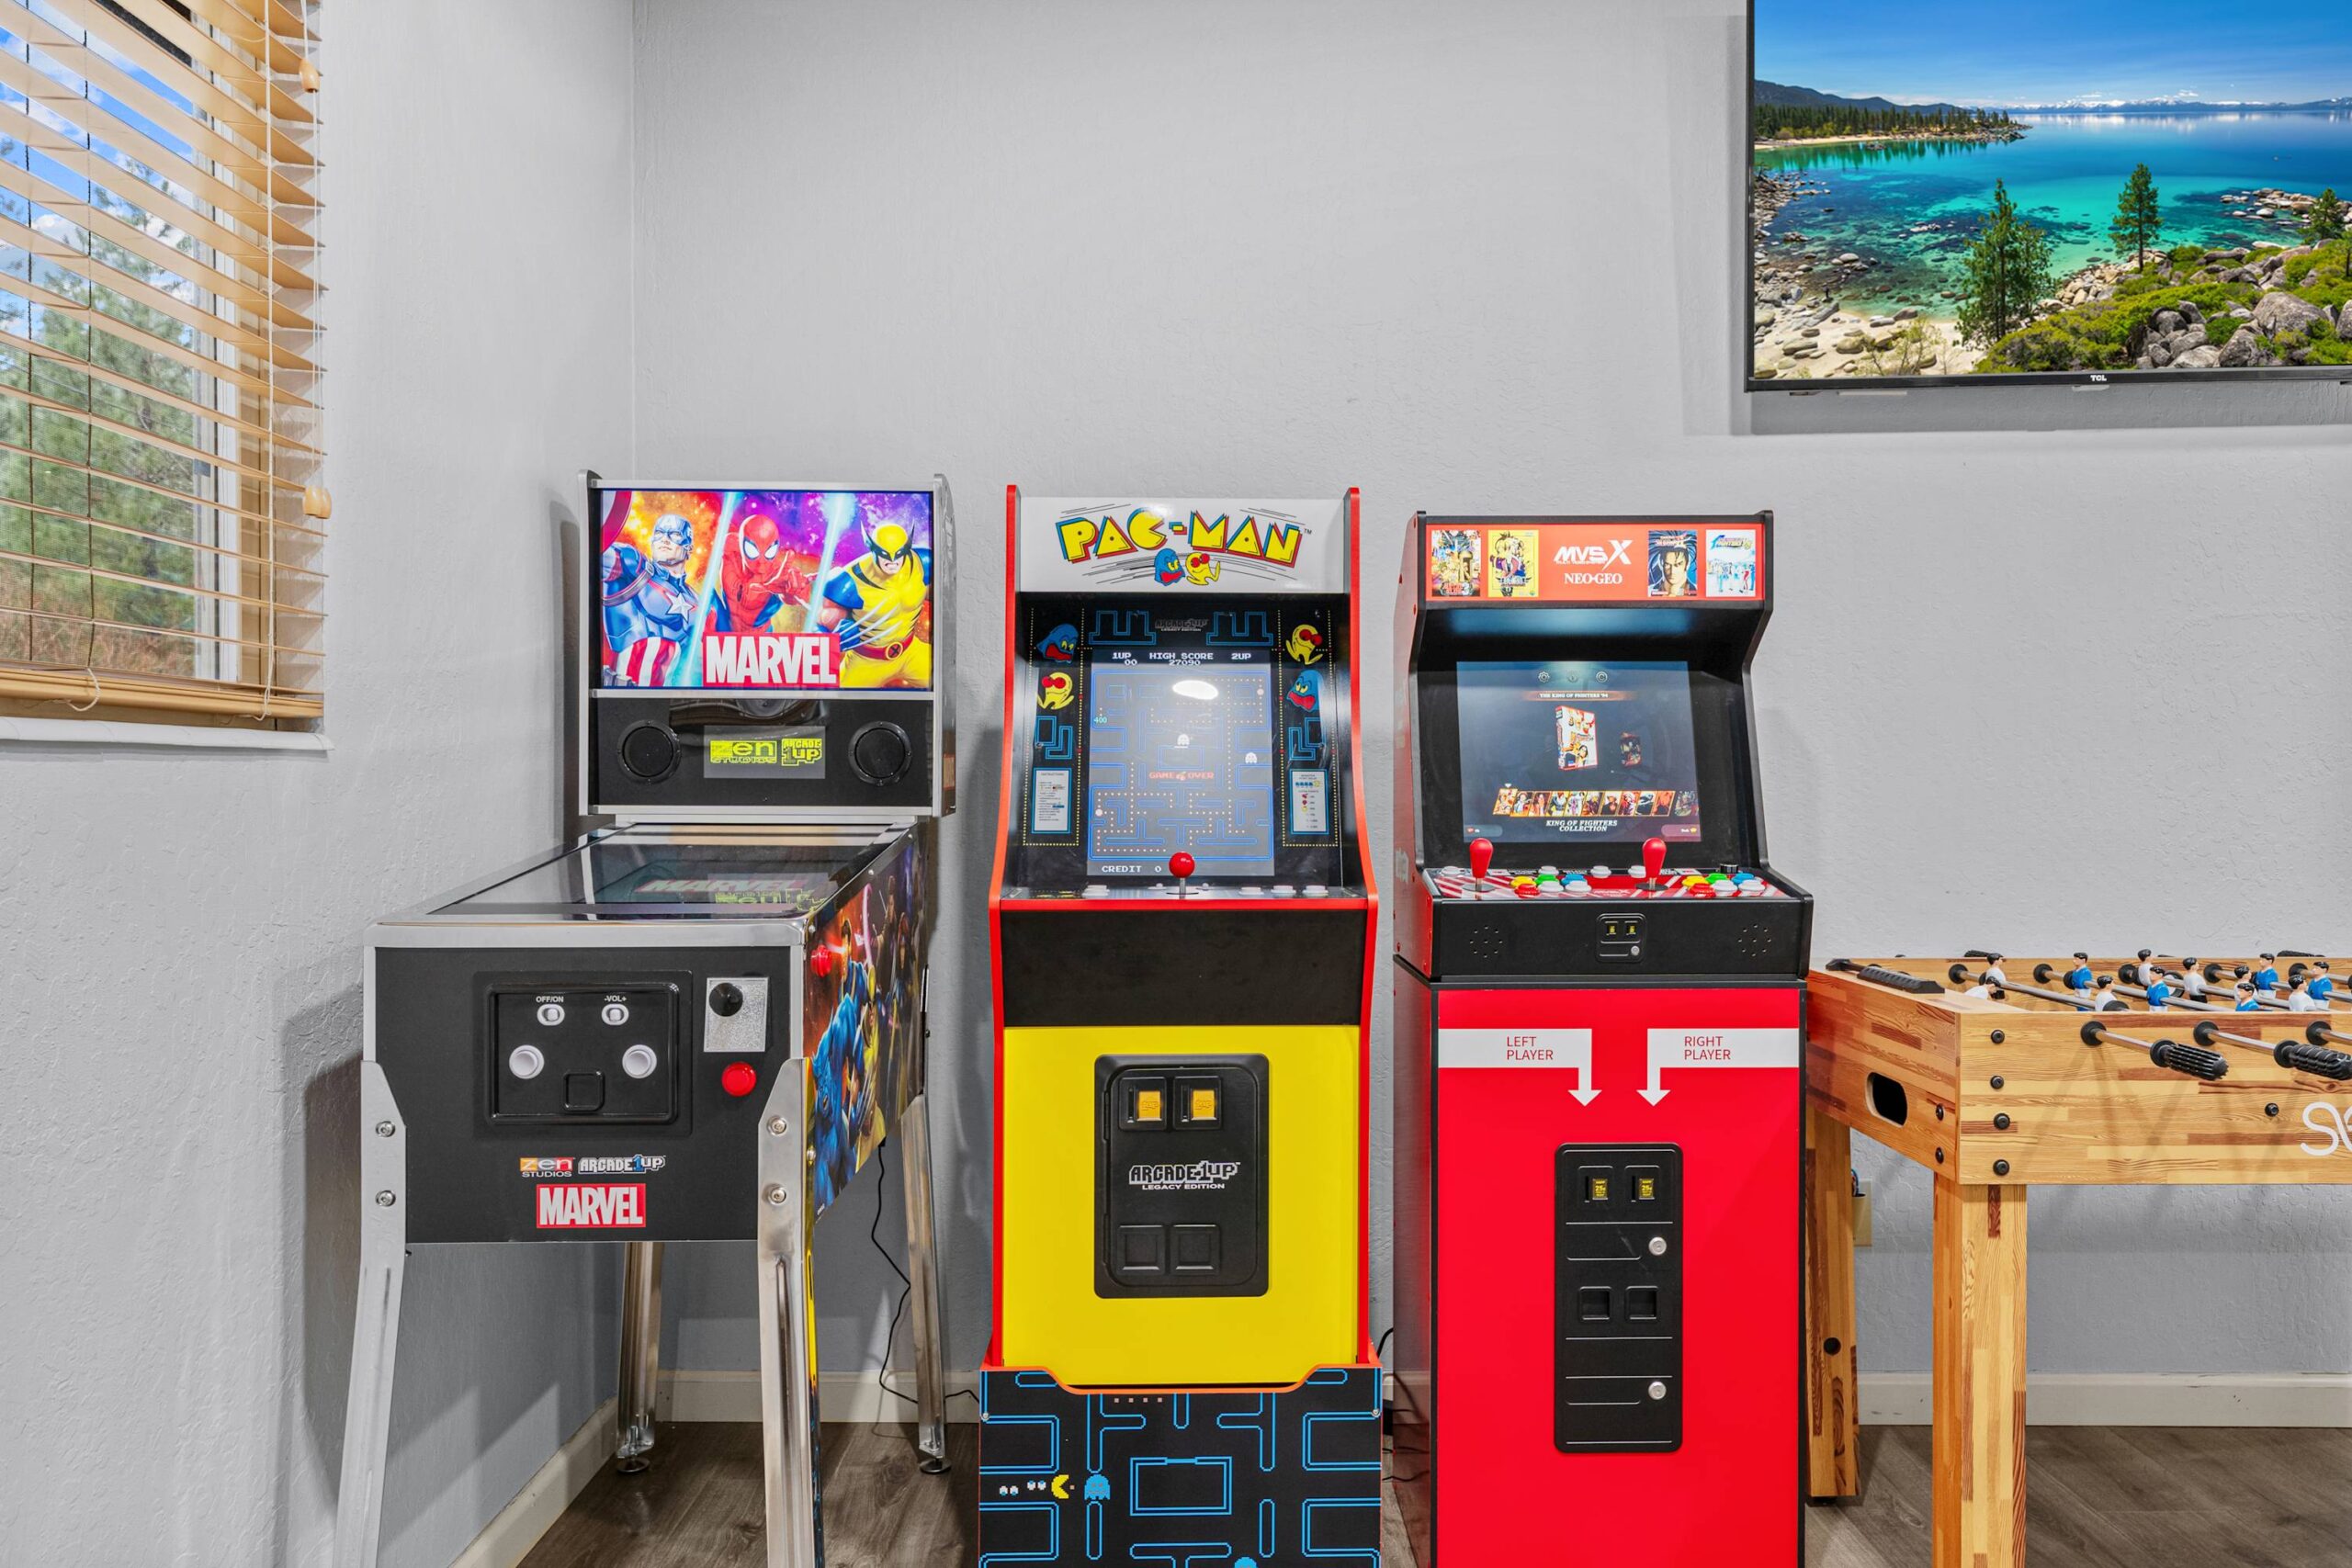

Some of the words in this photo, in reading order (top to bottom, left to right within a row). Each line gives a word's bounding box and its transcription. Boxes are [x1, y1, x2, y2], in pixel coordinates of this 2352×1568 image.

[1055, 507, 1303, 568] PAC-MAN
[1554, 539, 1633, 570] MVSX
[706, 635, 837, 684] MARVEL
[1506, 1035, 1537, 1047] LEFT
[1683, 1035, 1724, 1047] RIGHT
[1506, 1049, 1554, 1061] PLAYER
[1683, 1049, 1732, 1061] PLAYER
[520, 1157, 572, 1171] zen
[539, 1186, 644, 1226] MARVEL
